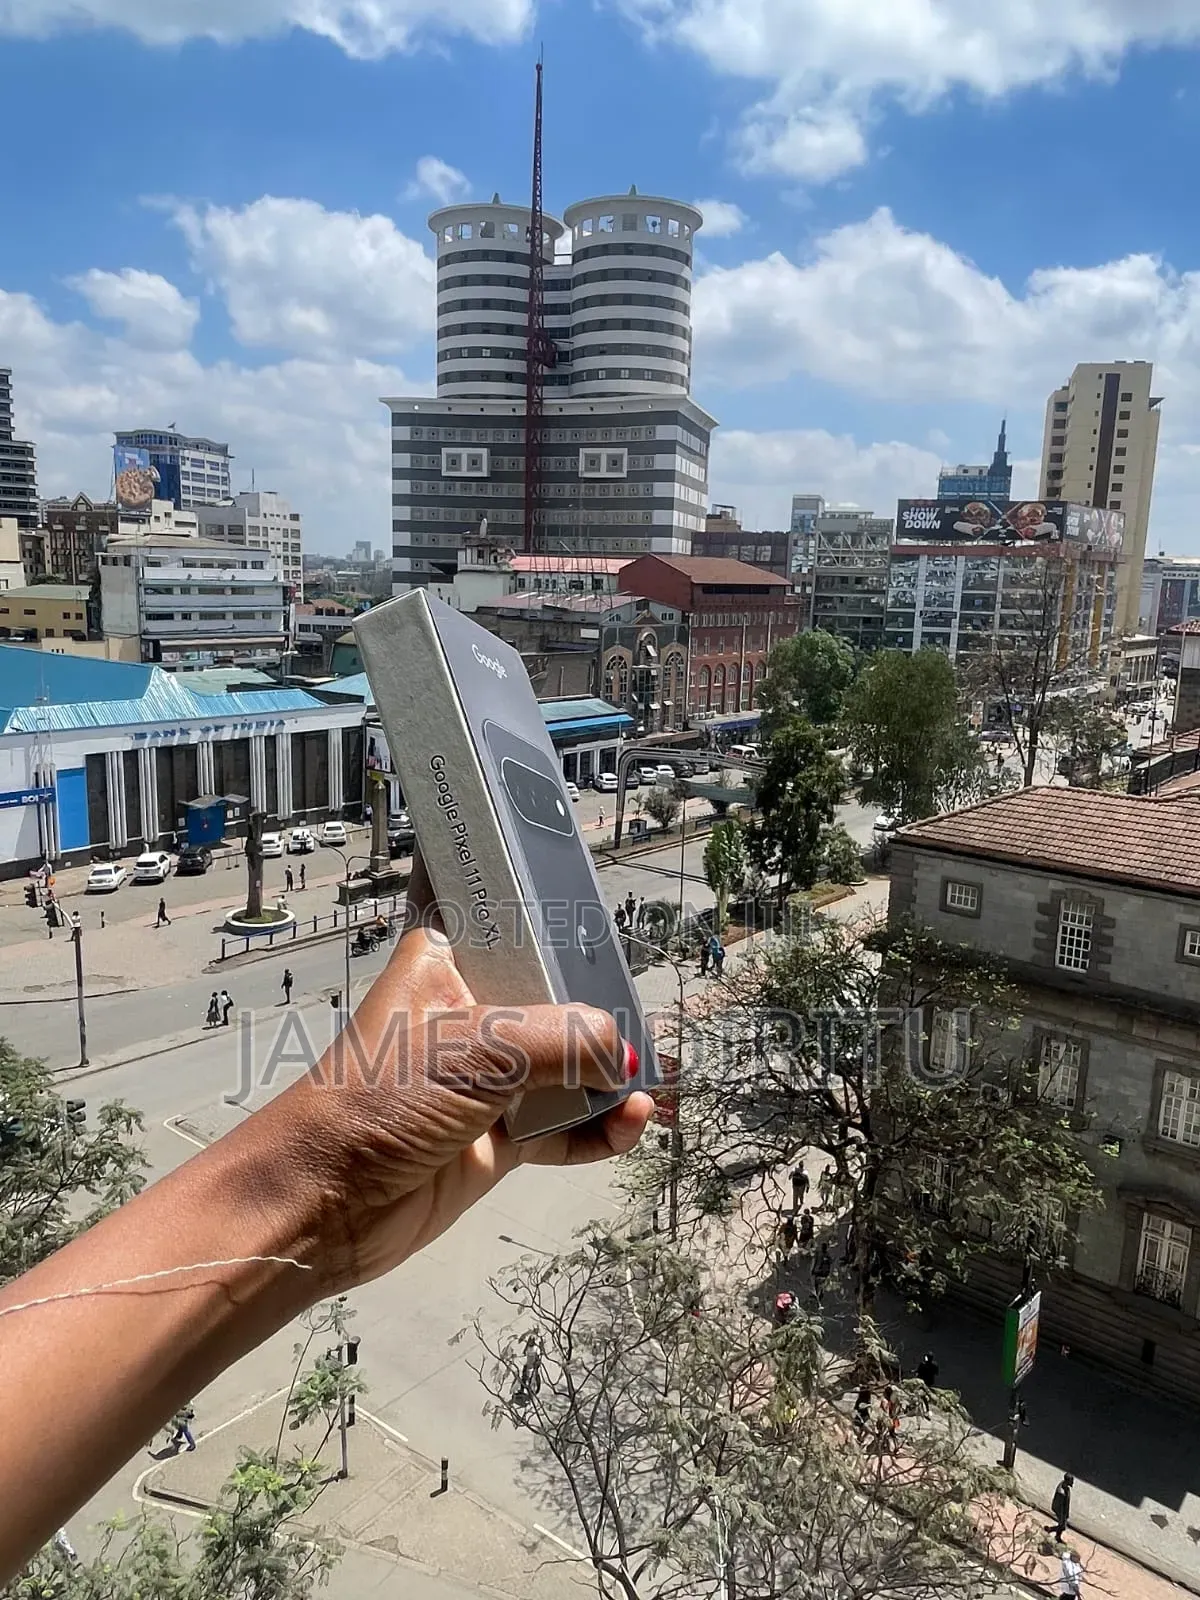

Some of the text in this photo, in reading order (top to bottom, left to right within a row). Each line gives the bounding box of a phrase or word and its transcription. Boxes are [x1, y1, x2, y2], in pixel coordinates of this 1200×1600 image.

[902, 511, 938, 520] SHOW
[905, 520, 941, 529] DOWN
[472, 644, 508, 679] Google
[134, 727, 190, 740] BANK
[430, 754, 502, 950] Google Pixel 11 Pro XL
